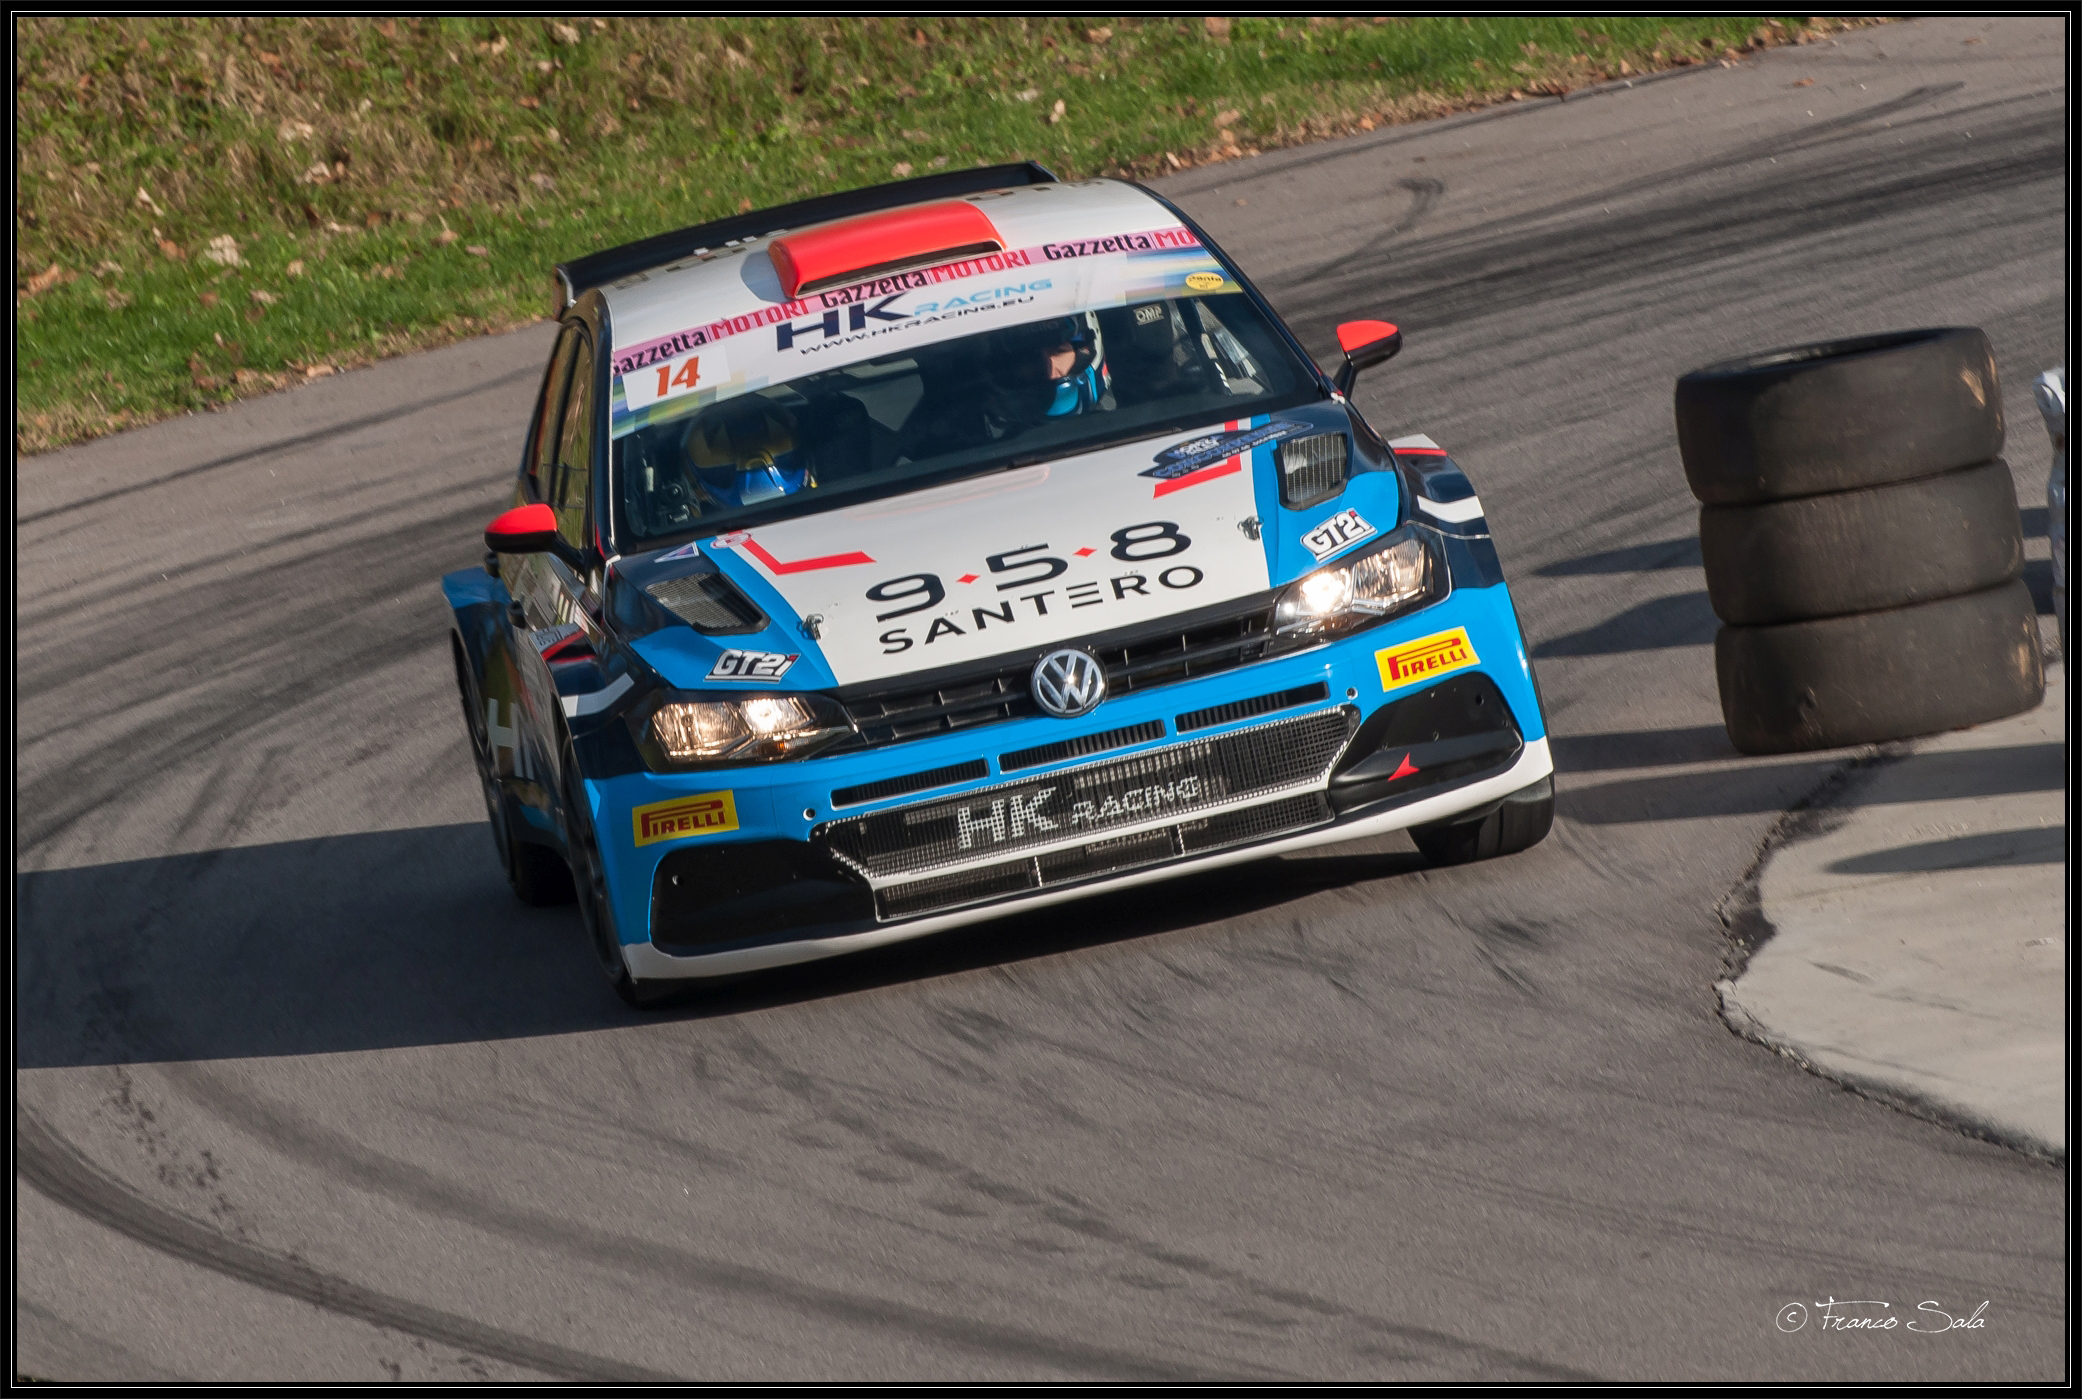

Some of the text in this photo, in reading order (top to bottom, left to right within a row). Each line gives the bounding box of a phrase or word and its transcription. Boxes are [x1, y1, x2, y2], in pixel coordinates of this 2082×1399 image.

[710, 299, 809, 340] MOTORI
[819, 271, 928, 309] Gazzetta
[931, 249, 1031, 283] MOTORI
[1042, 234, 1152, 261] Gazzetta
[776, 278, 1053, 353] HK RACING
[800, 295, 1034, 355] WWW.HKRACING.EU
[1135, 305, 1163, 325] OMP
[656, 355, 701, 399] 14
[1301, 508, 1373, 554] GT2i
[878, 565, 1204, 655] SANTERO
[712, 648, 799, 677] GT2i
[1387, 637, 1468, 682] PIRELLI
[640, 799, 726, 839] PIRELLI
[957, 775, 1199, 850] HK RACING
